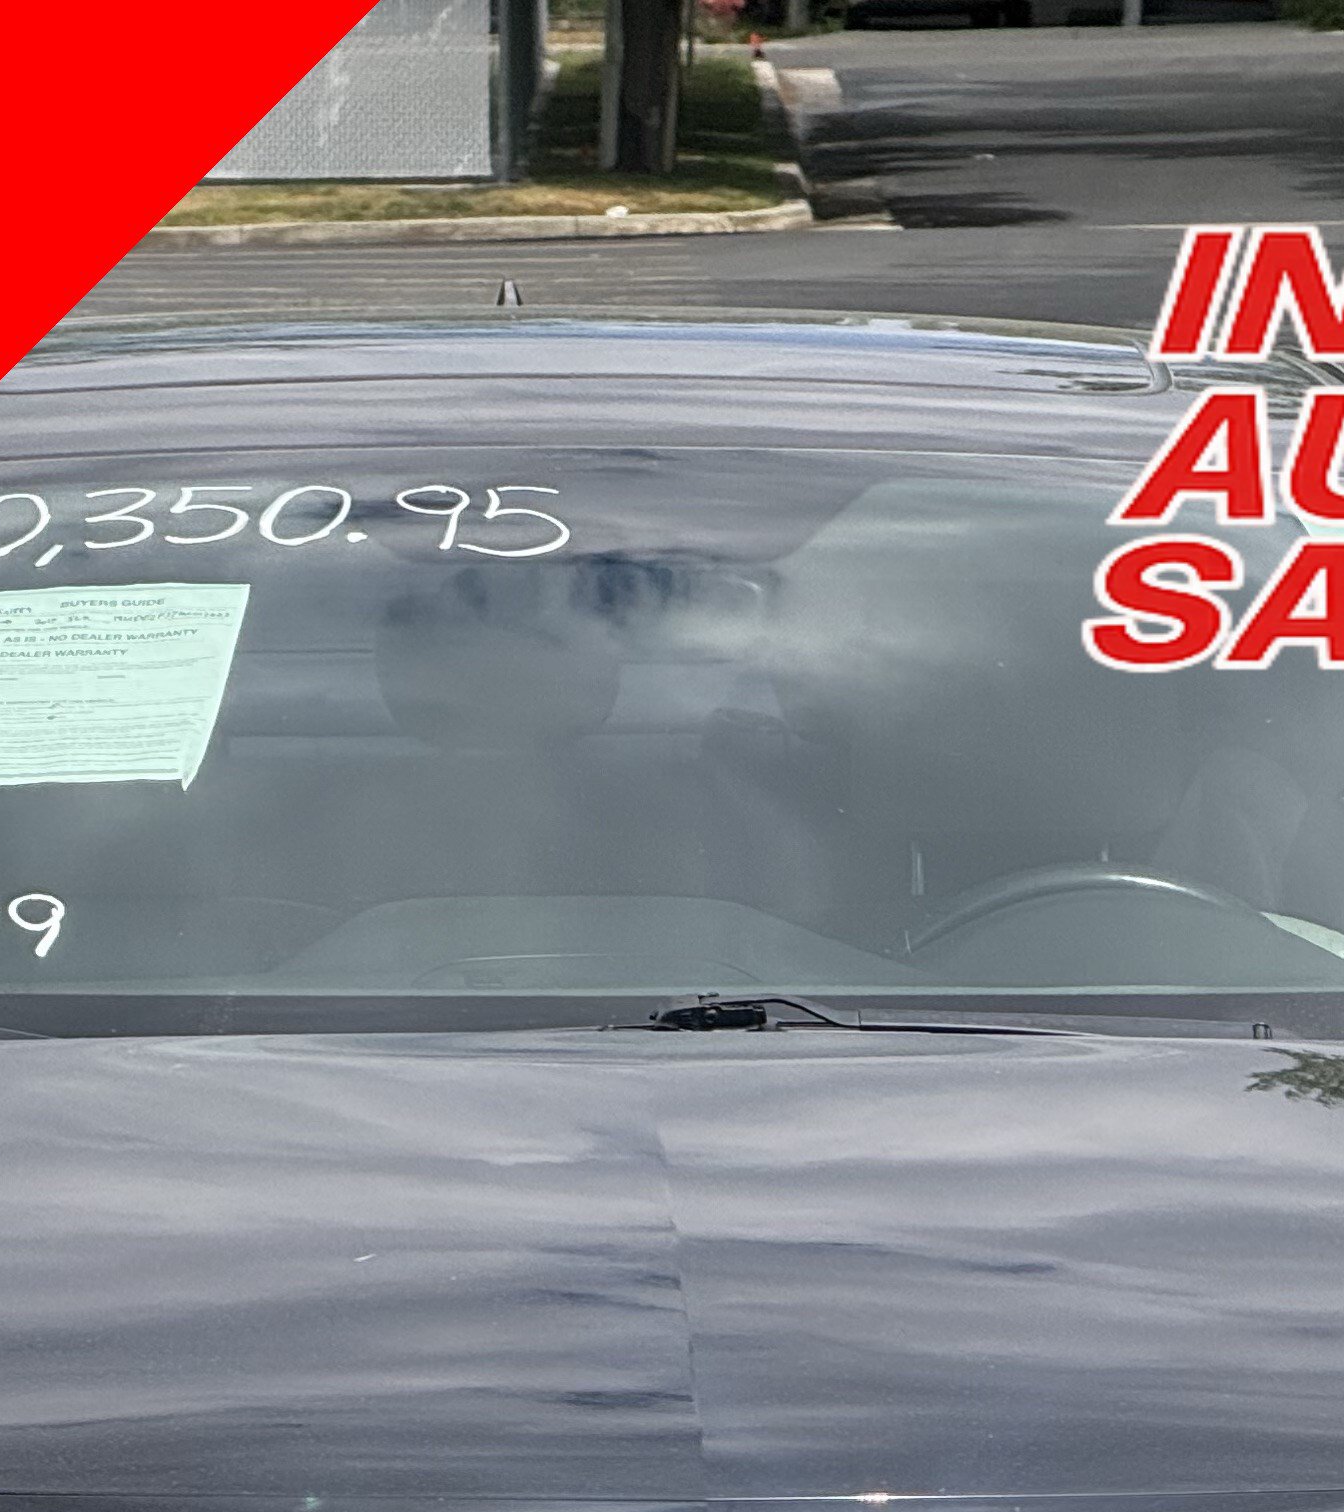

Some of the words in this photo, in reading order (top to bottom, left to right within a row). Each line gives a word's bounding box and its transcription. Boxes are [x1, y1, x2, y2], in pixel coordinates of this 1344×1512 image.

[60, 600, 117, 608] BUYERS
[121, 598, 165, 606] GUIDE
[71, 633, 123, 641] DEALER
[126, 629, 198, 640] WARRANTY
[55, 648, 129, 657] WARRANTY
